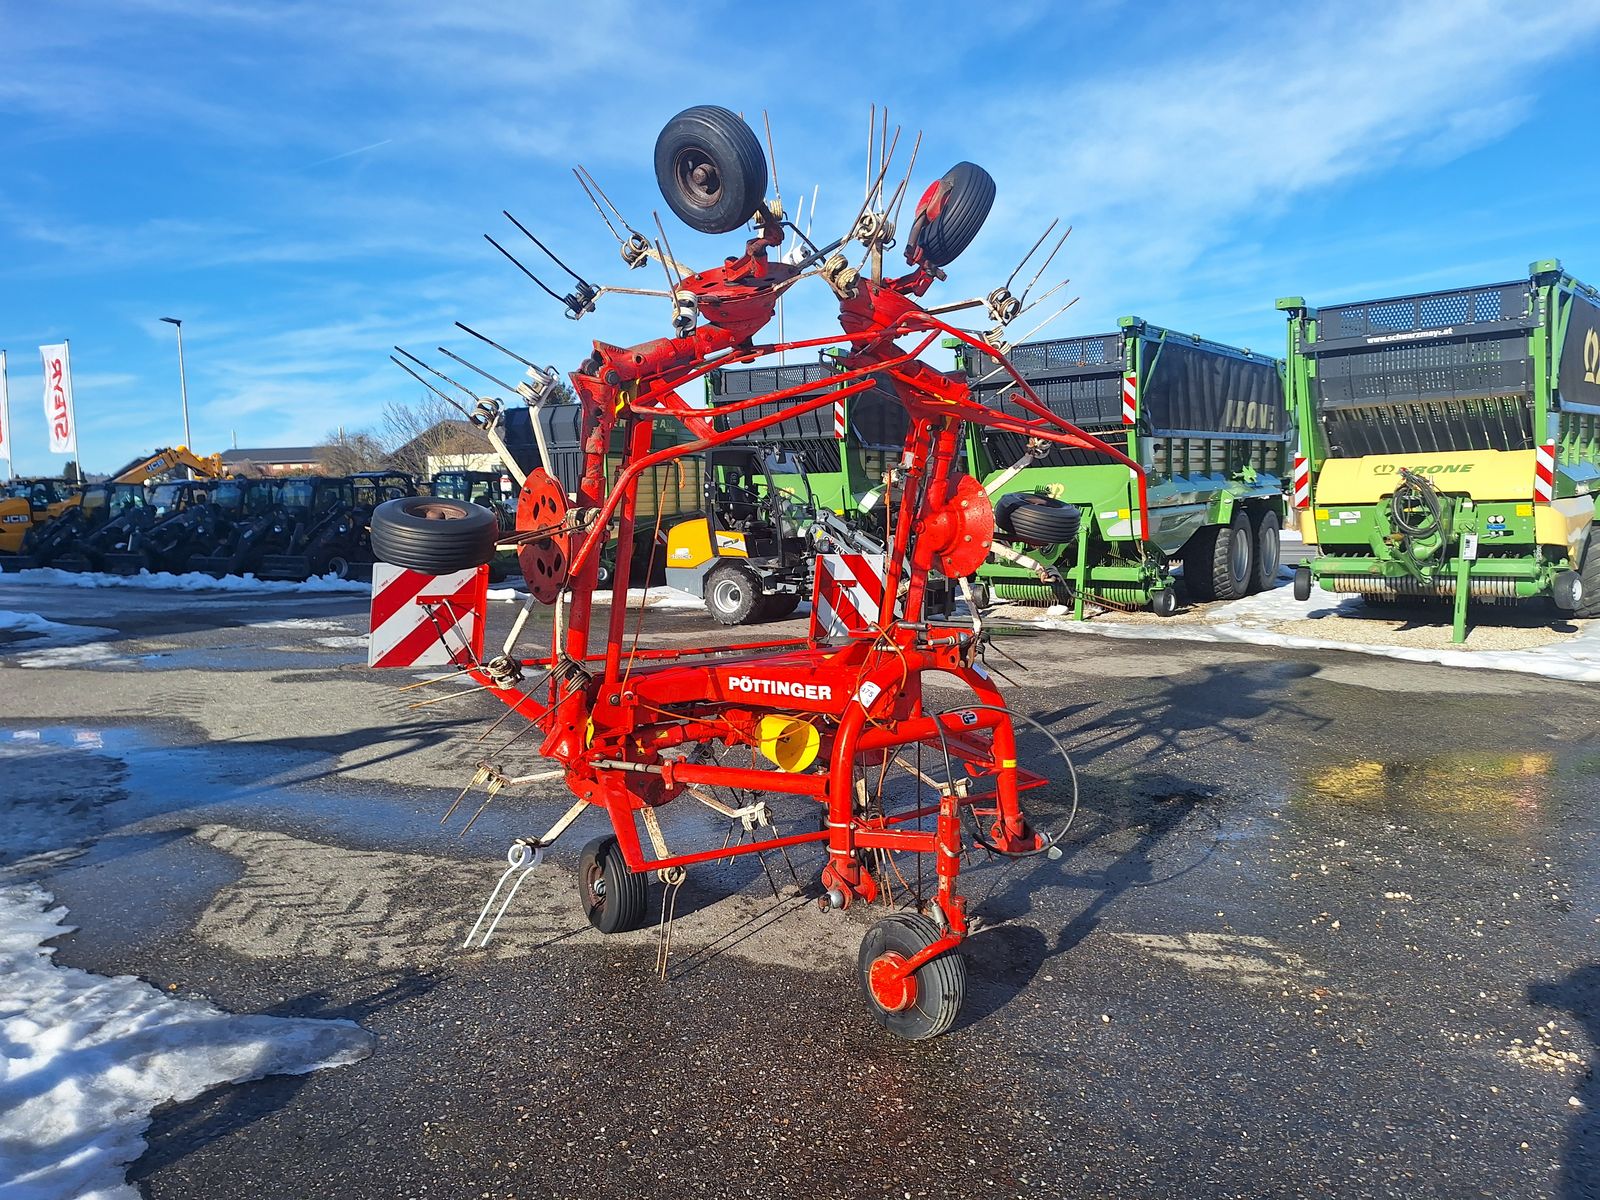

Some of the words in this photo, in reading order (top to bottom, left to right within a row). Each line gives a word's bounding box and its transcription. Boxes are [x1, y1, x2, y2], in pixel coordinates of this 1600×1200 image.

[1367, 327, 1453, 343] www.schwarzmayr.at
[146, 458, 165, 473] JCB
[1397, 464, 1475, 475] RONE
[3, 515, 29, 523] JCB
[728, 675, 832, 700] PÖTTINGER
